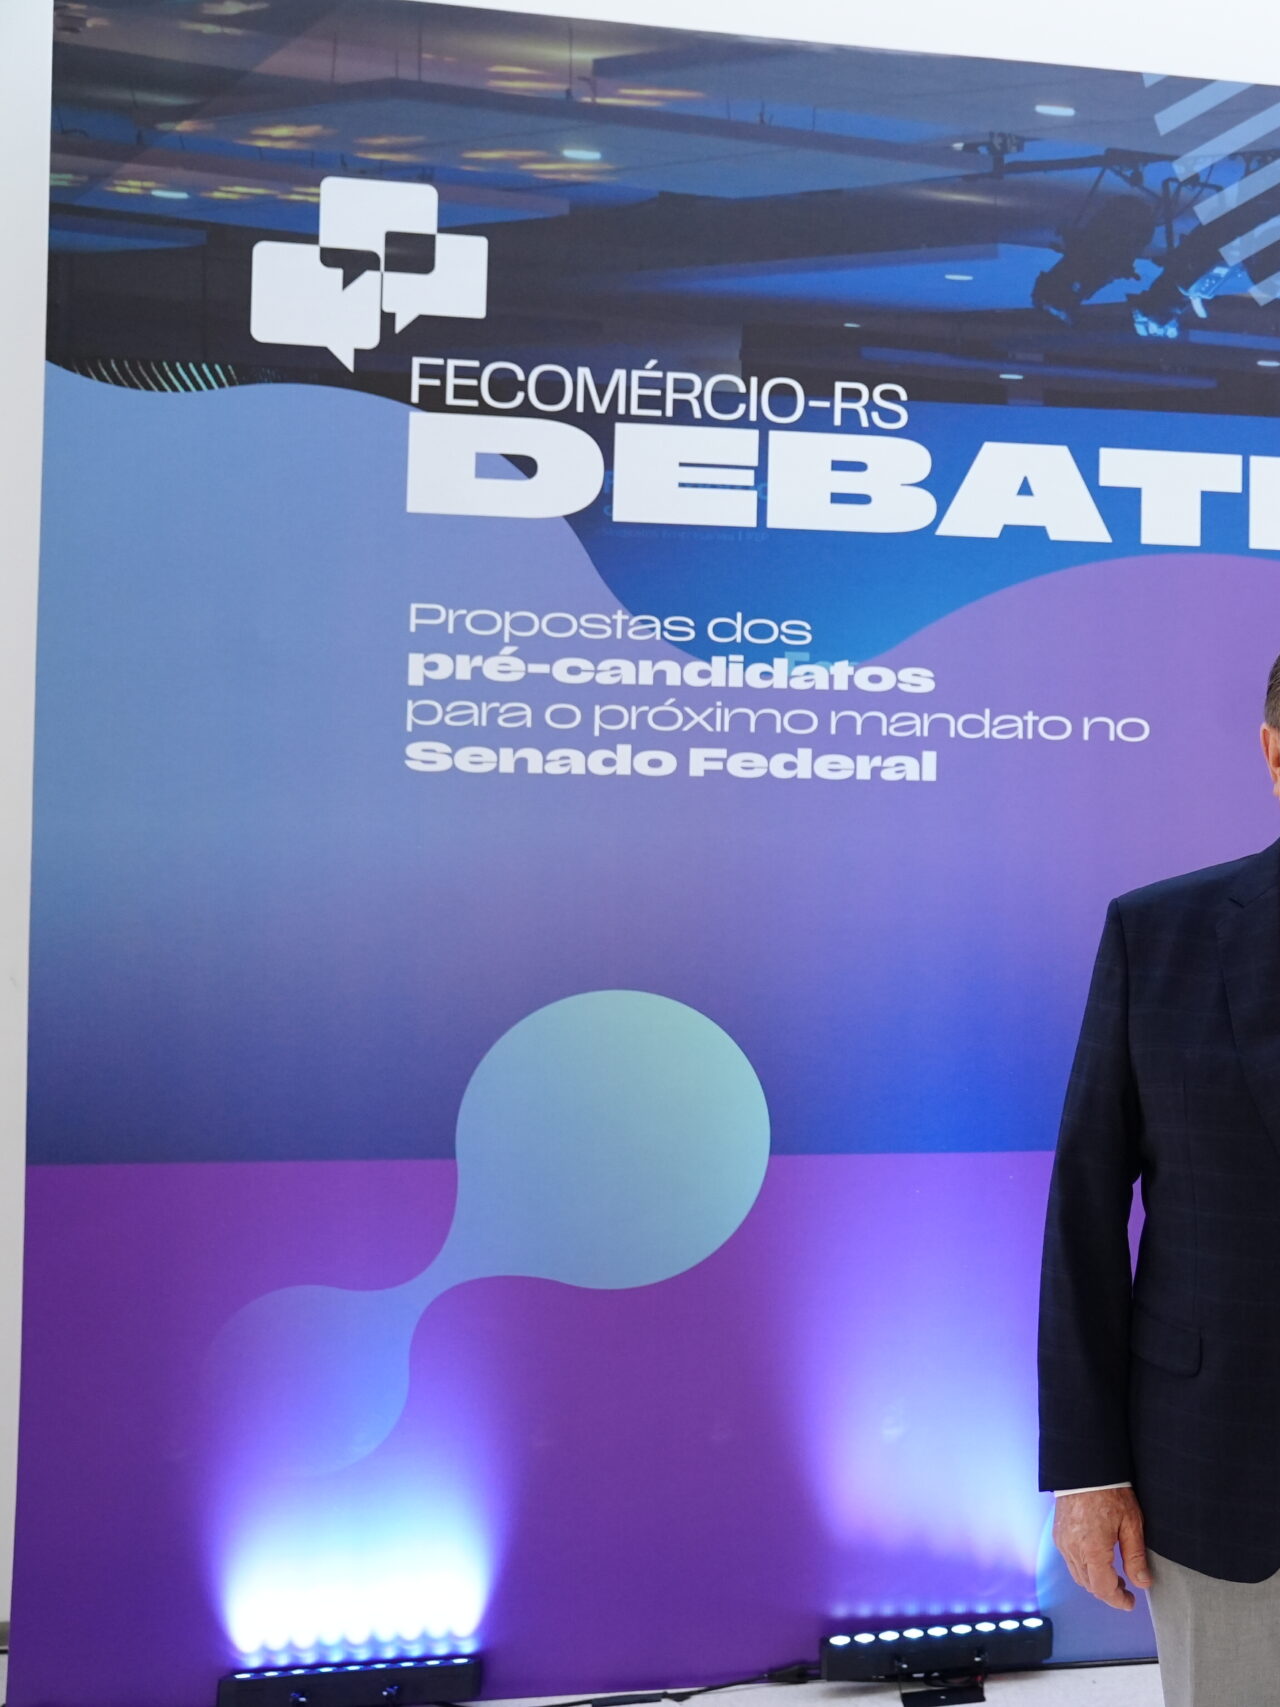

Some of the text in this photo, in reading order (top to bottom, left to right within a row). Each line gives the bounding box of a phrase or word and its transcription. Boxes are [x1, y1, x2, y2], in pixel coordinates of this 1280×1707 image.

[410, 356, 909, 430] FECOMÉRCIO-RS
[409, 602, 813, 646] Propostas dos
[407, 645, 936, 694] pré-candidatos
[405, 697, 1151, 743] para o próximo mandato no
[404, 741, 937, 782] Senado Federal
